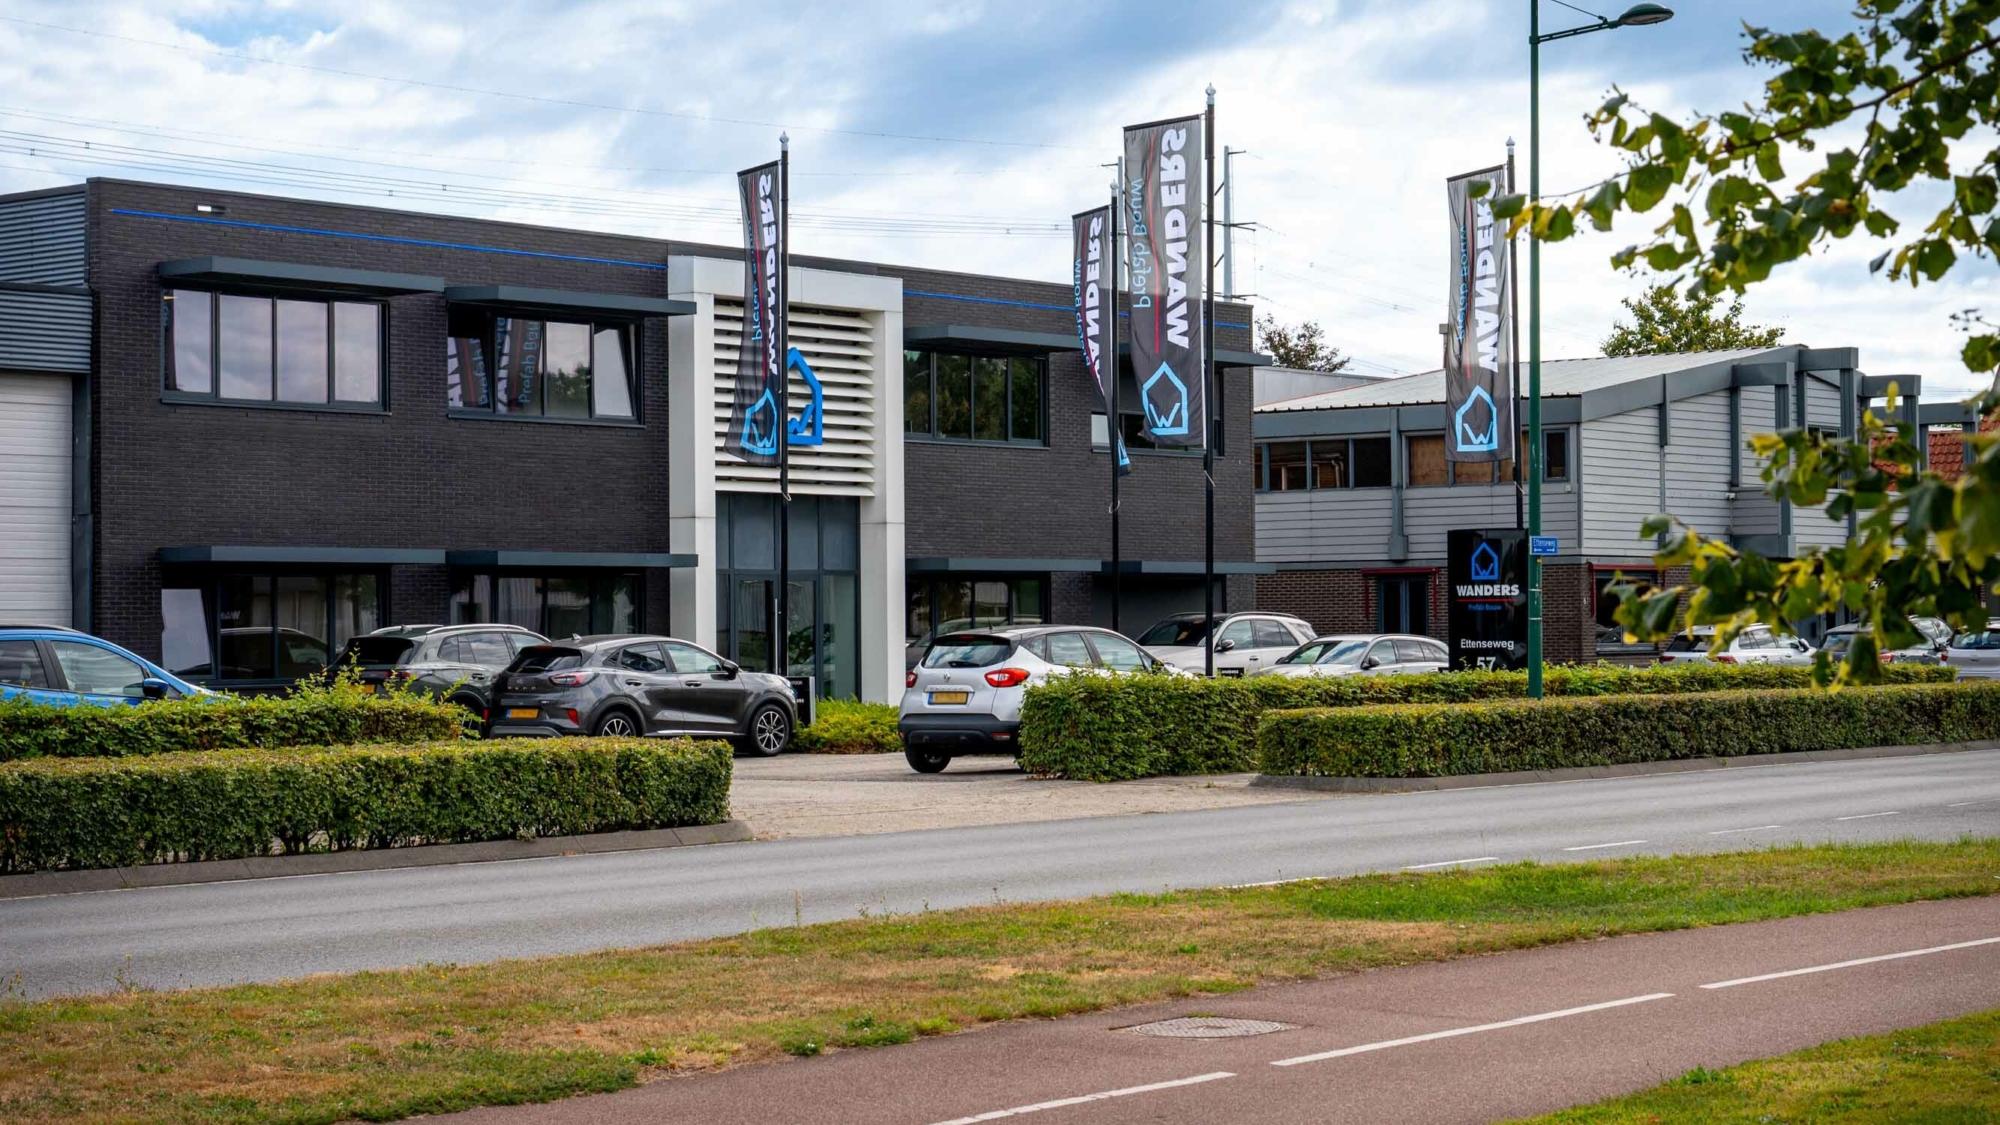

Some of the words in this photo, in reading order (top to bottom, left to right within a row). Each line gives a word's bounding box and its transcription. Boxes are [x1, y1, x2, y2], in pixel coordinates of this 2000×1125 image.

[522, 321, 541, 351] Bou
[1456, 584, 1520, 597] WANDERS
[1460, 638, 1515, 650] Ettenseweg
[1476, 656, 1496, 673] 57
